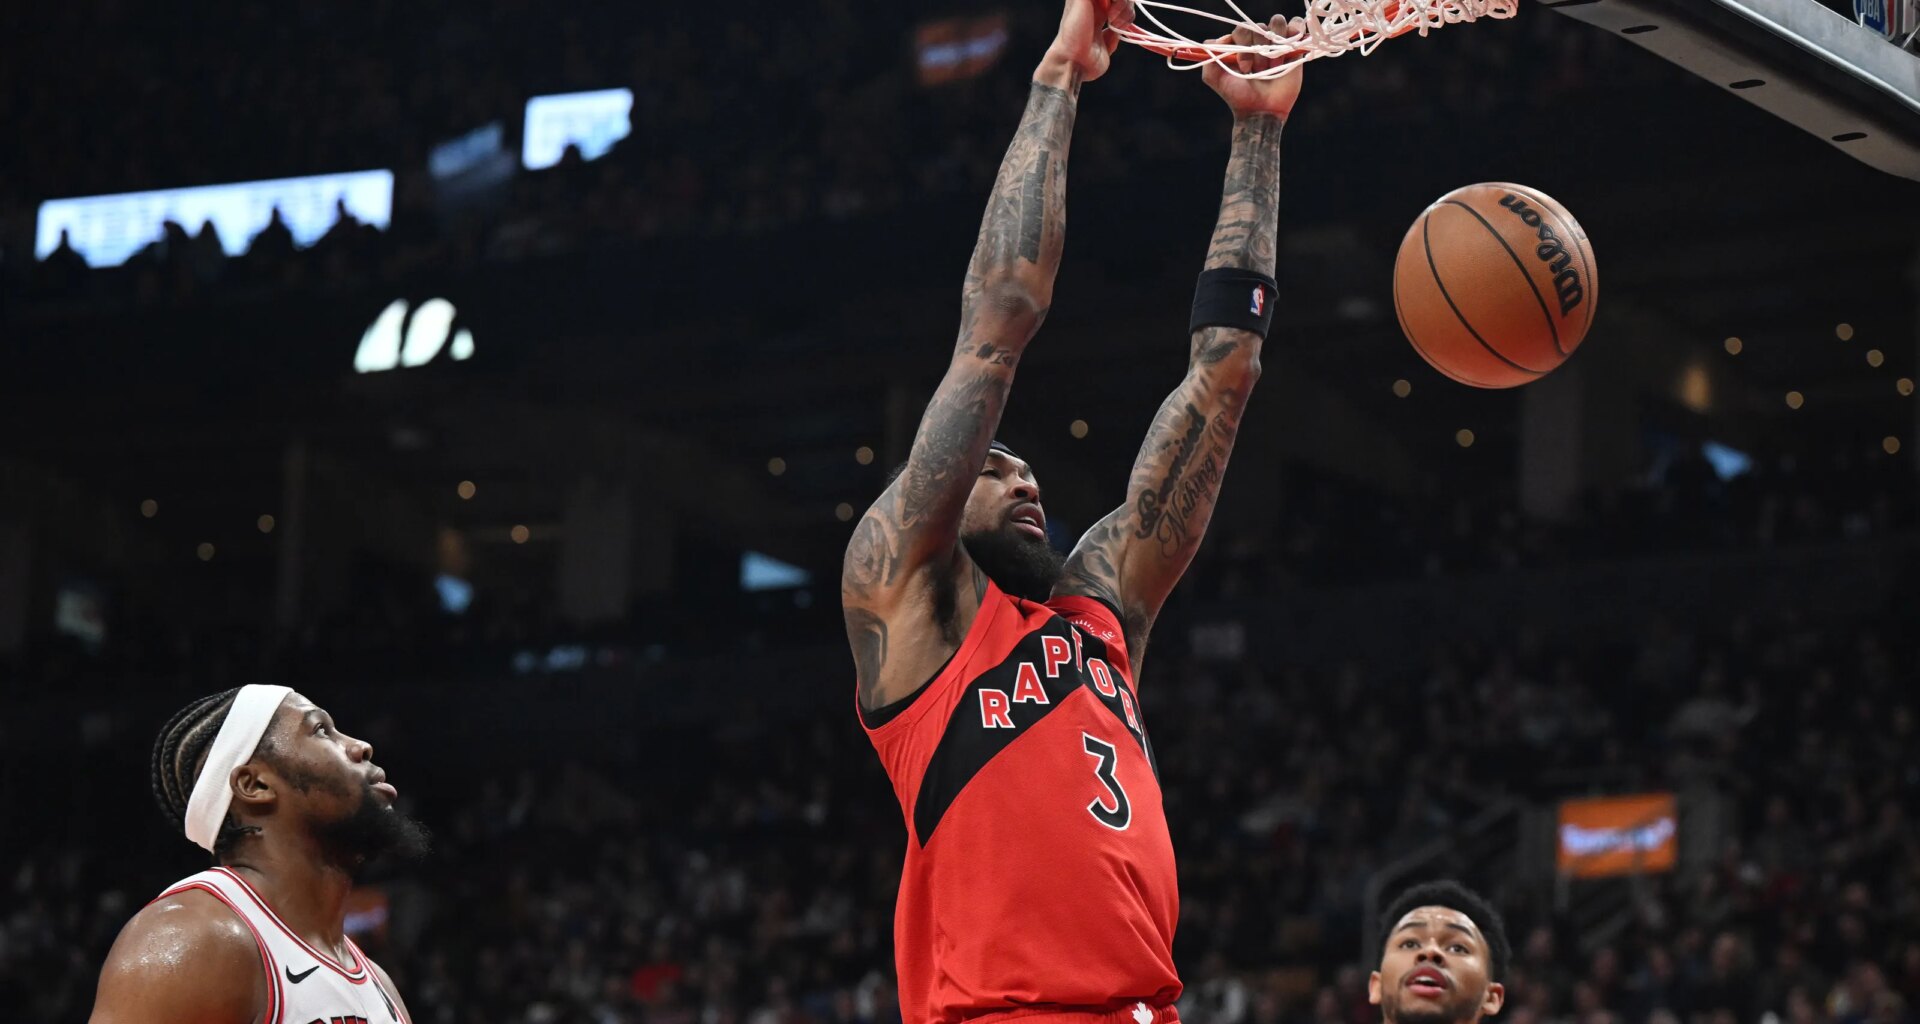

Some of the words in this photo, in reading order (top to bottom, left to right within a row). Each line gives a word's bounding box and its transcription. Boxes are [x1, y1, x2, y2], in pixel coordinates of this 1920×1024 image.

[1498, 194, 1584, 319] Wilson
[1157, 453, 1217, 558] Nothing
[978, 625, 1151, 767] RAPTOR
[1082, 731, 1132, 831] 3
